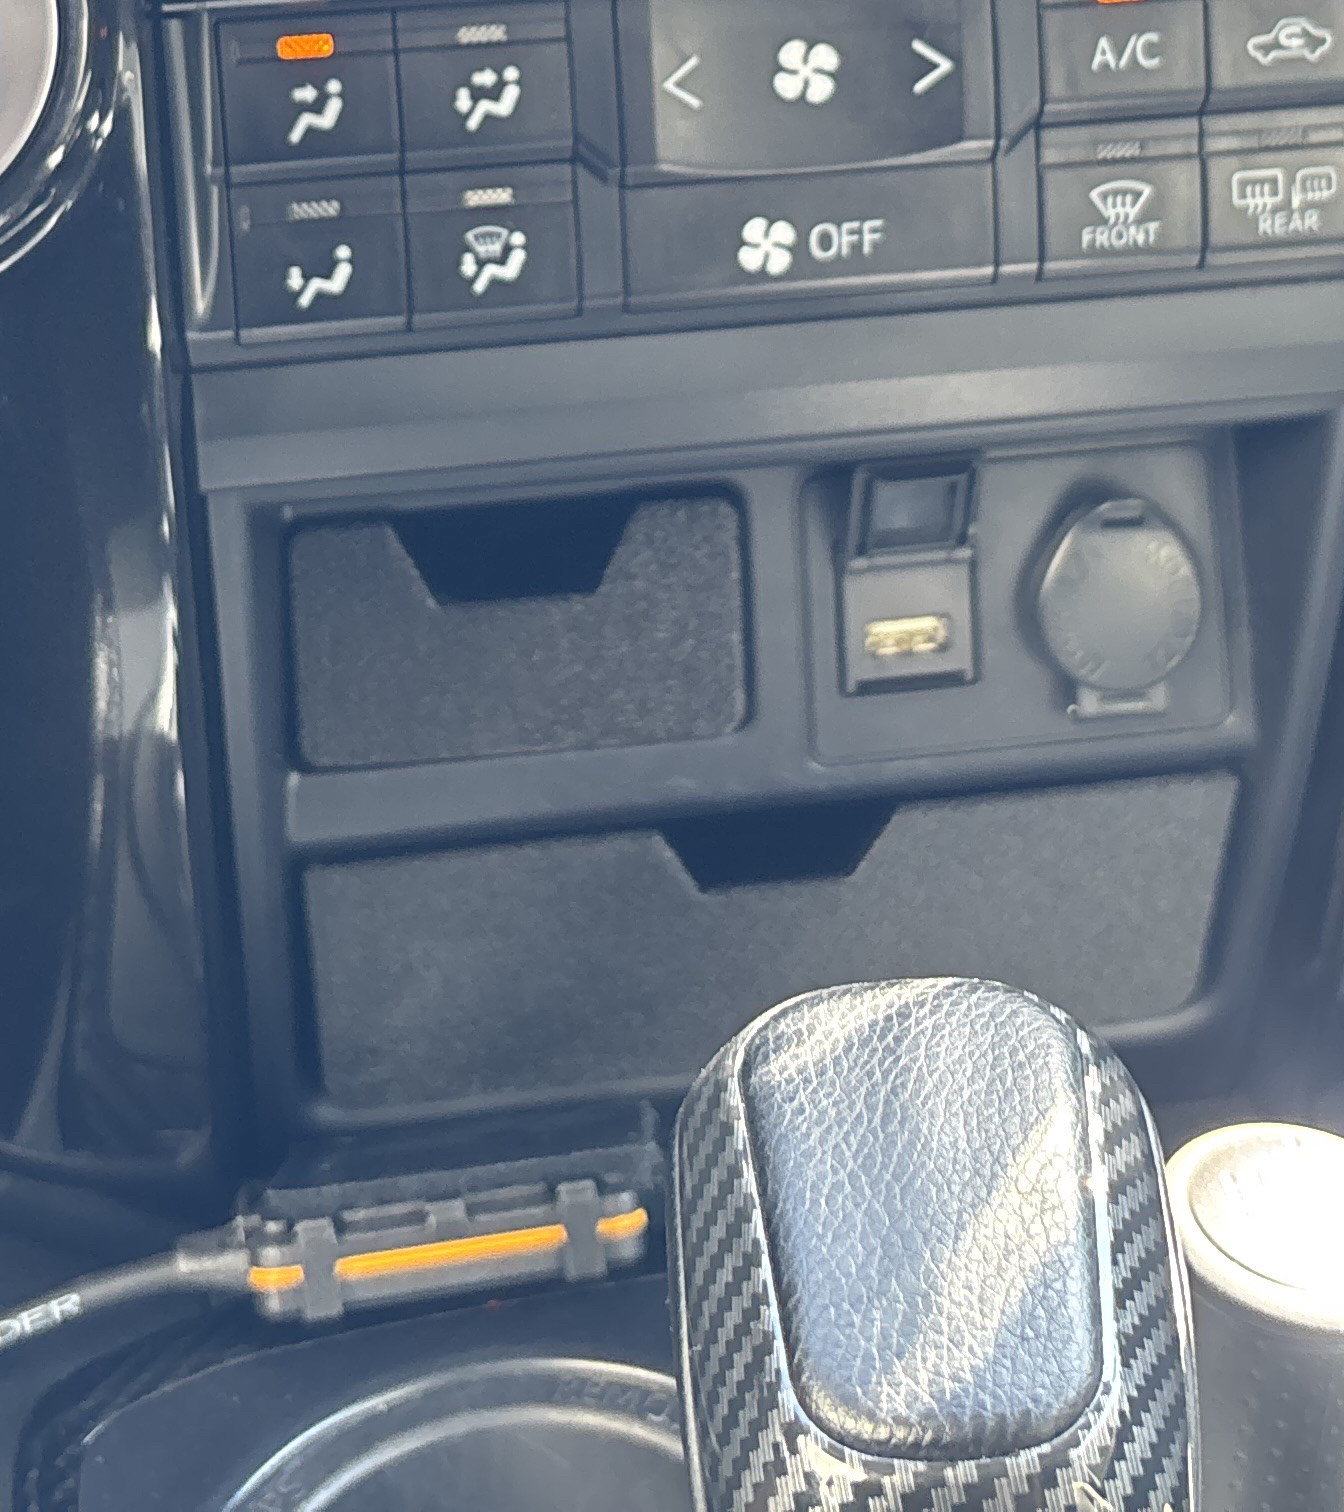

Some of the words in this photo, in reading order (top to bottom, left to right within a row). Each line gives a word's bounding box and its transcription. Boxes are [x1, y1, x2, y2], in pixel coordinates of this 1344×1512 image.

[1091, 32, 1162, 71] A/C
[808, 218, 885, 261] OFF
[1081, 219, 1161, 250] FRONT
[1258, 208, 1322, 236] REAR
